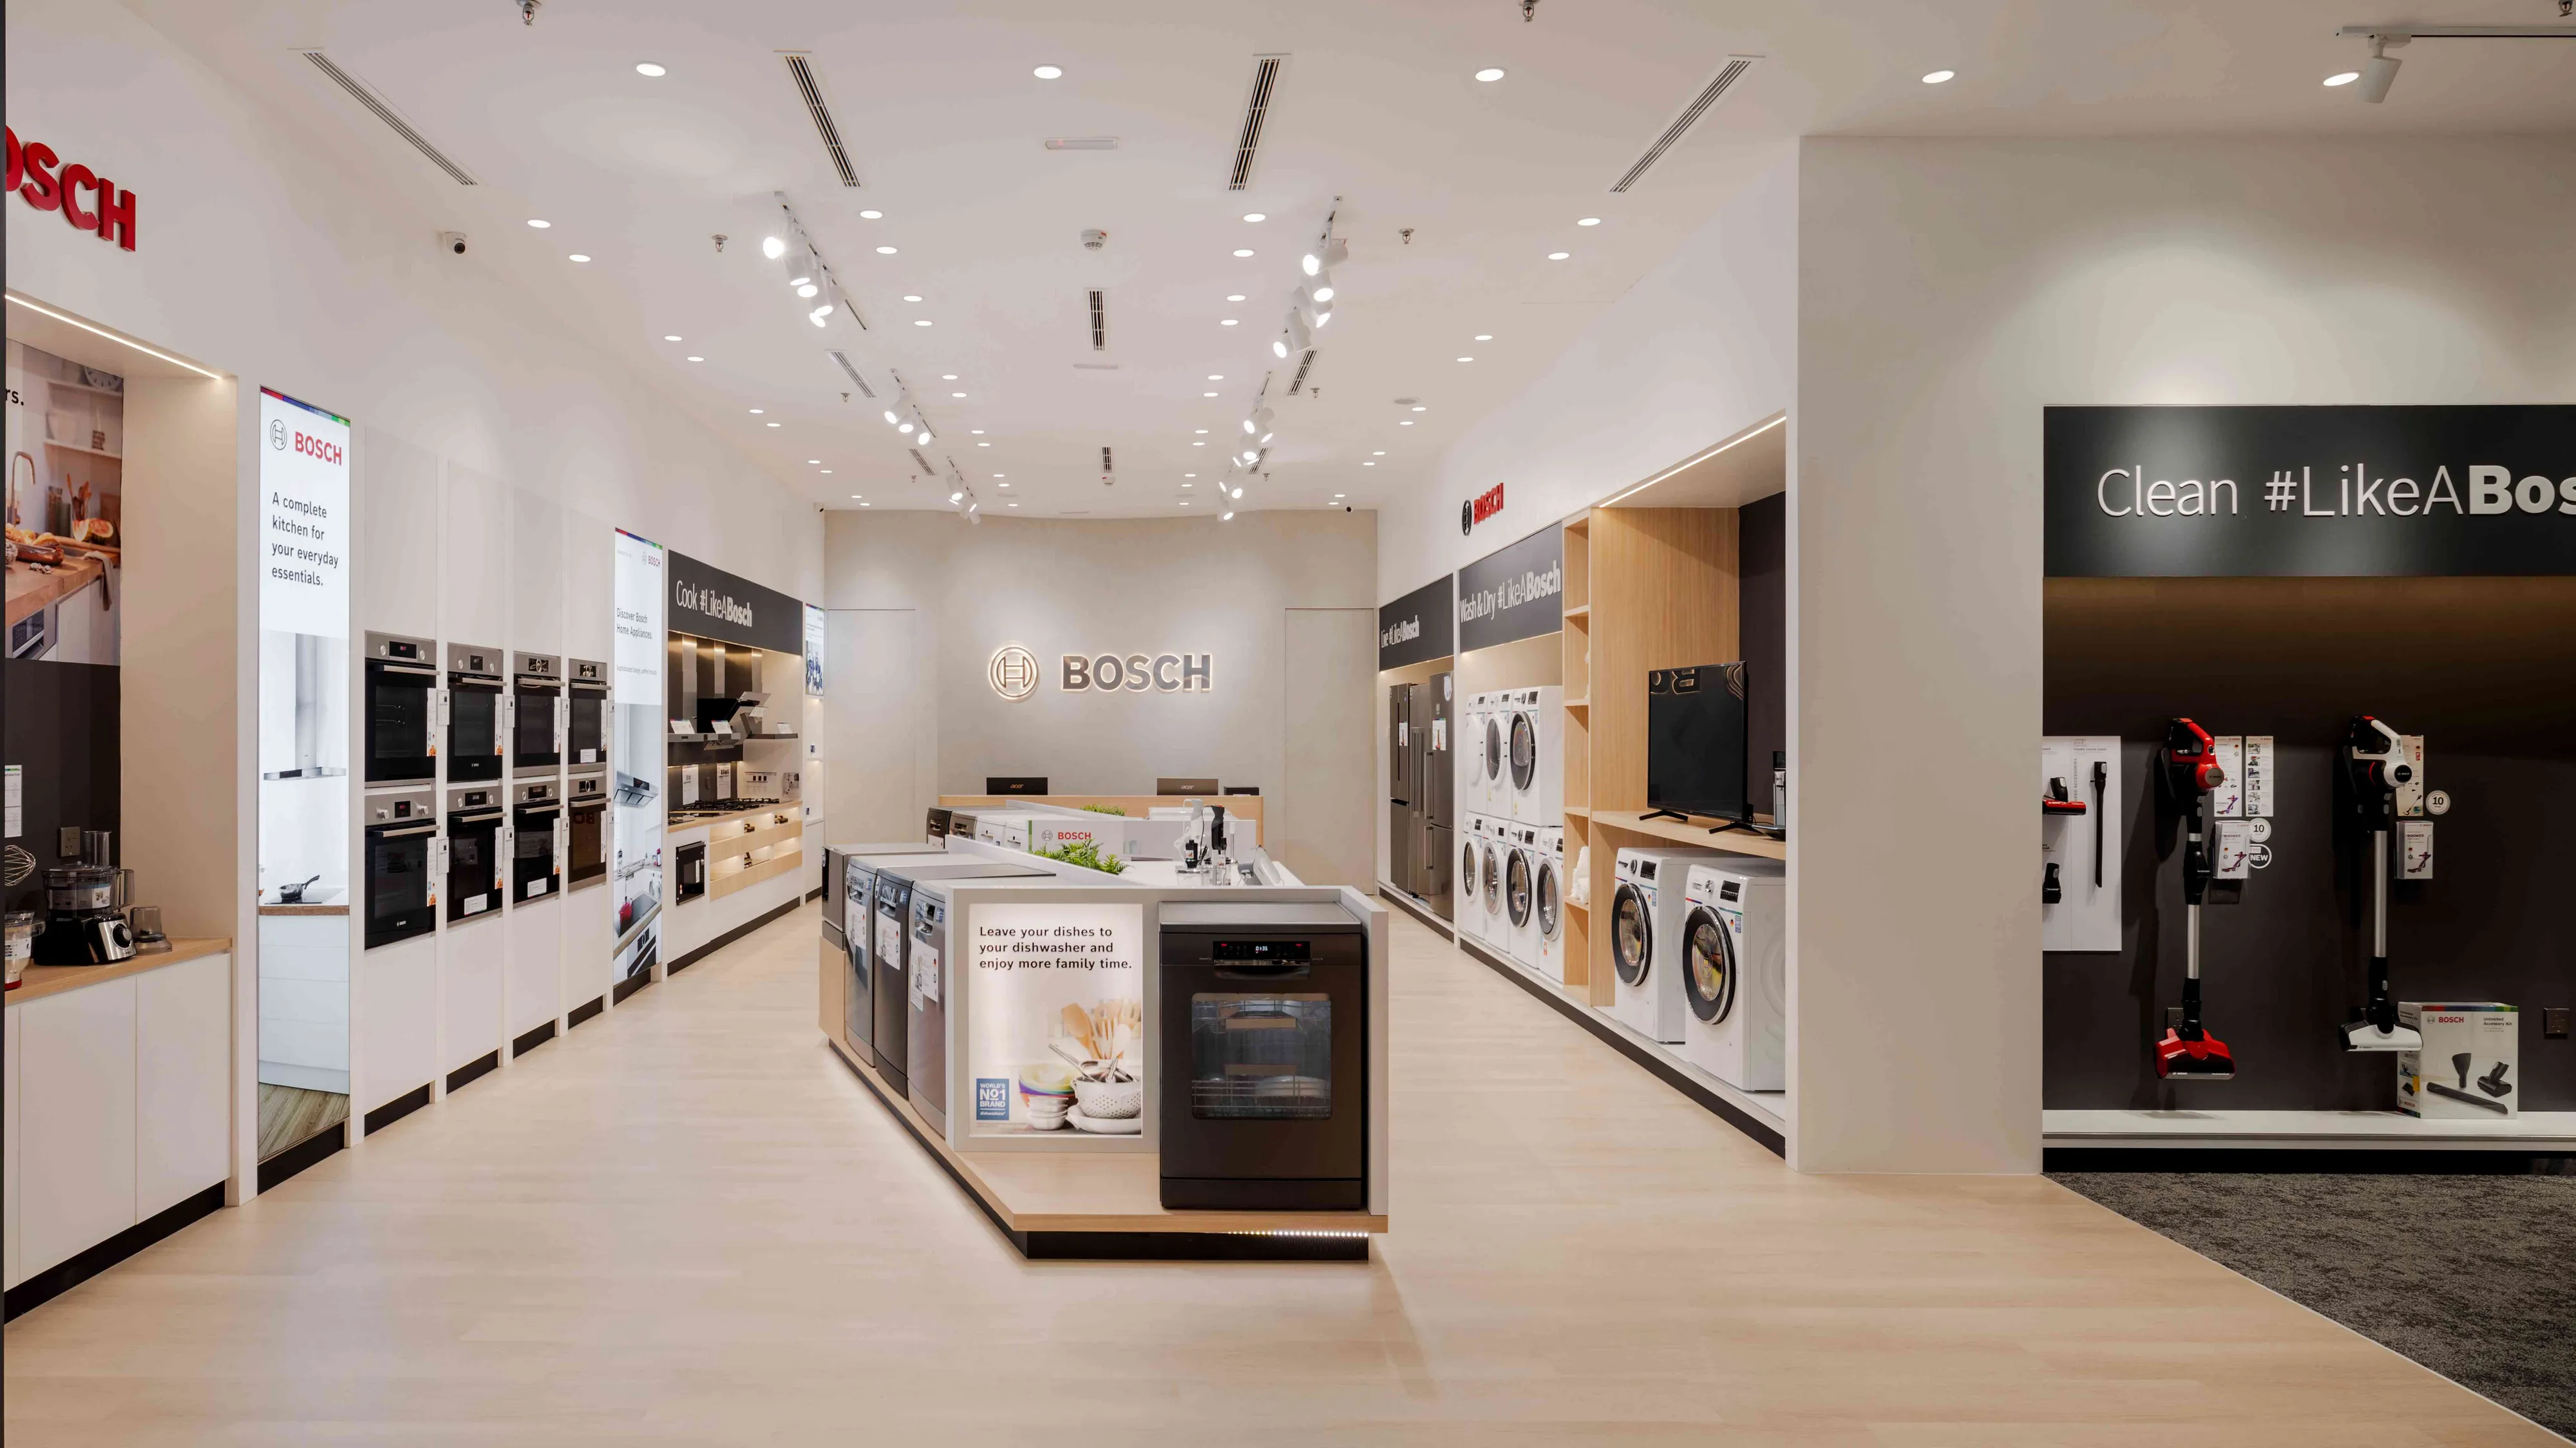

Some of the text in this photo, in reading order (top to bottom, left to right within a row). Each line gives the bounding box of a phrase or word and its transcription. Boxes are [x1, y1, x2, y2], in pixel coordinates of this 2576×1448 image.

[295, 431, 342, 466] BOSCH
[2097, 465, 2239, 517] Clean
[272, 491, 327, 518] A complete
[1473, 482, 1504, 525] BOSCH
[272, 515, 325, 540] kitchen for
[272, 542, 339, 569] your everyday
[648, 555, 661, 567] BOSCH
[272, 567, 323, 586] essentials.
[1459, 560, 1561, 623] Wash & Dry #LikeABosch
[676, 580, 752, 627] Cook #LikeABosch
[617, 607, 647, 624] Discover Bosch
[617, 623, 652, 640] Home Appliances.
[1062, 653, 1211, 692] BOSCH
[2432, 797, 2444, 805] 10
[1057, 832, 1092, 840] BOSCH
[2254, 824, 2264, 833] 10
[980, 926, 1112, 938] Leave your dishes to
[980, 942, 1113, 954] your dishwasher and
[980, 958, 1132, 971] enjoy more family time.
